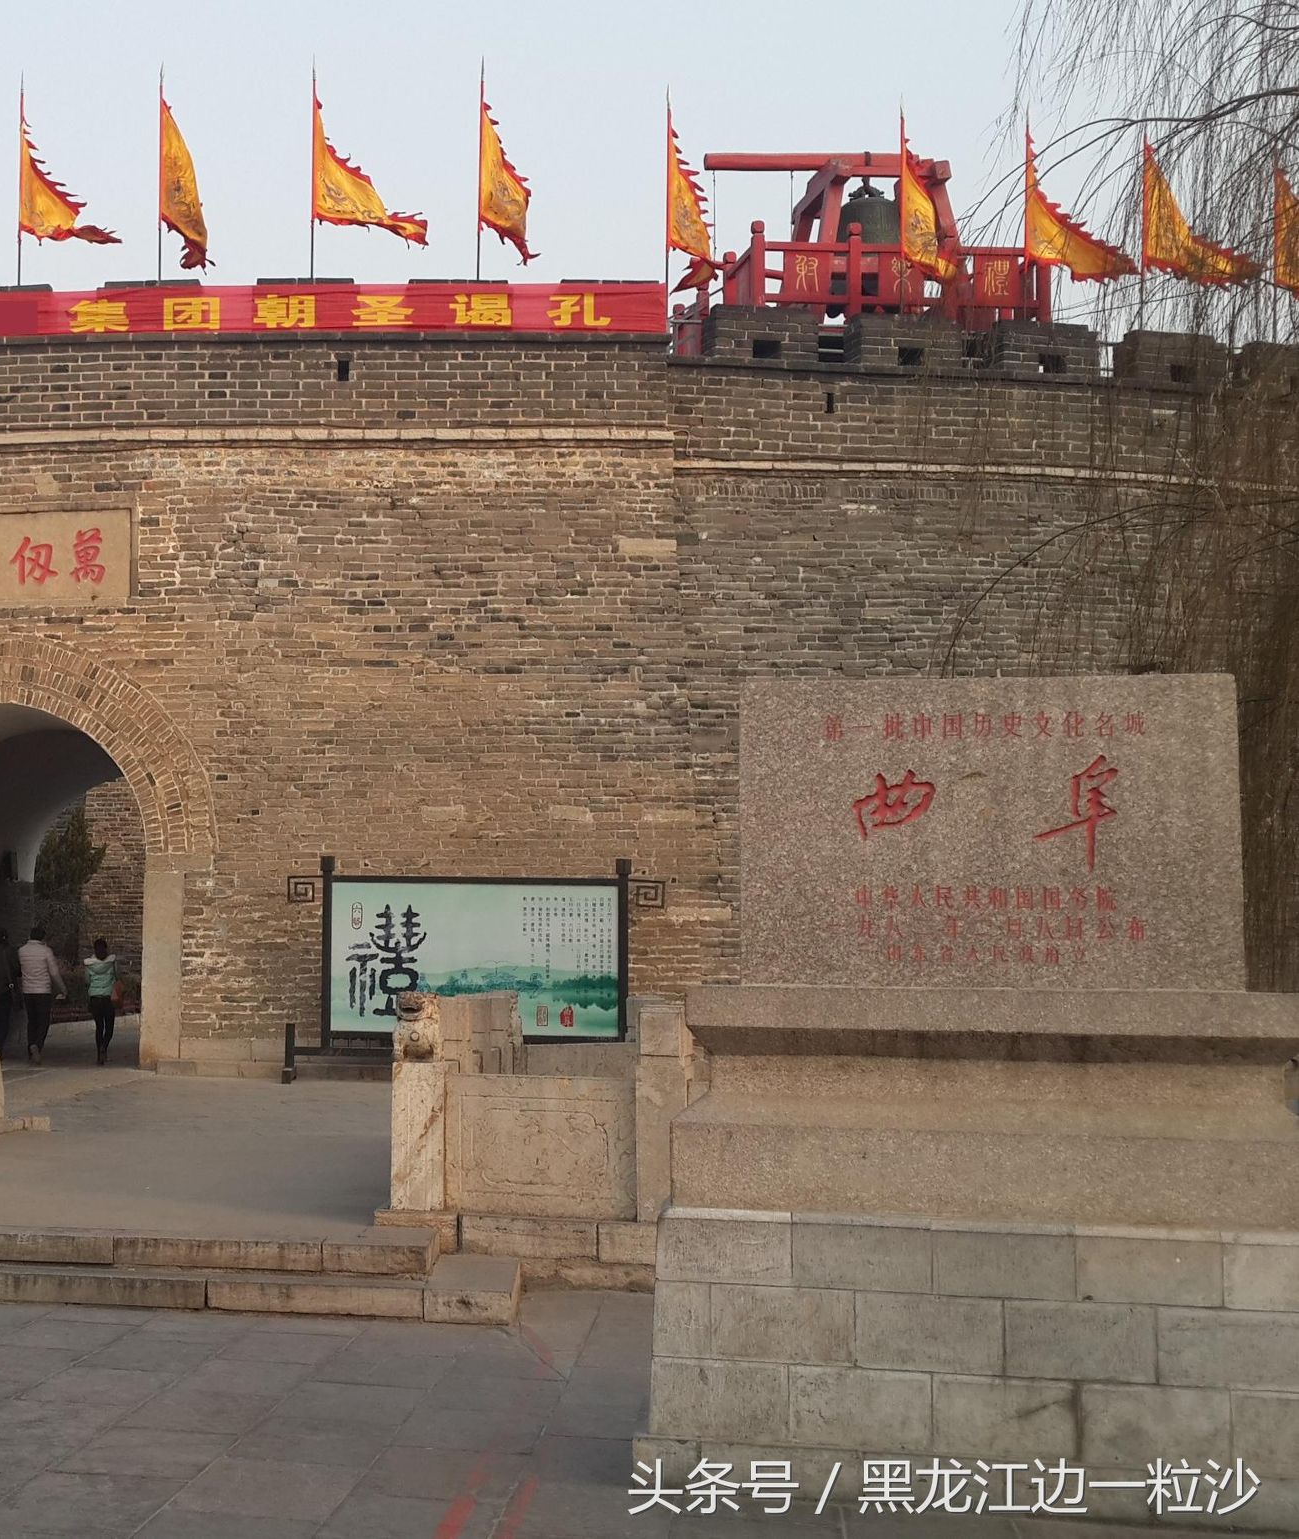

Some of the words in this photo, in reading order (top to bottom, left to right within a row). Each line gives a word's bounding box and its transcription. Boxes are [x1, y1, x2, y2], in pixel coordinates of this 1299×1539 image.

[68, 292, 612, 333] 集团朝圣谒孔
[822, 710, 1147, 741] 第一批中国历史文化名城
[852, 755, 1119, 873] 曲阜
